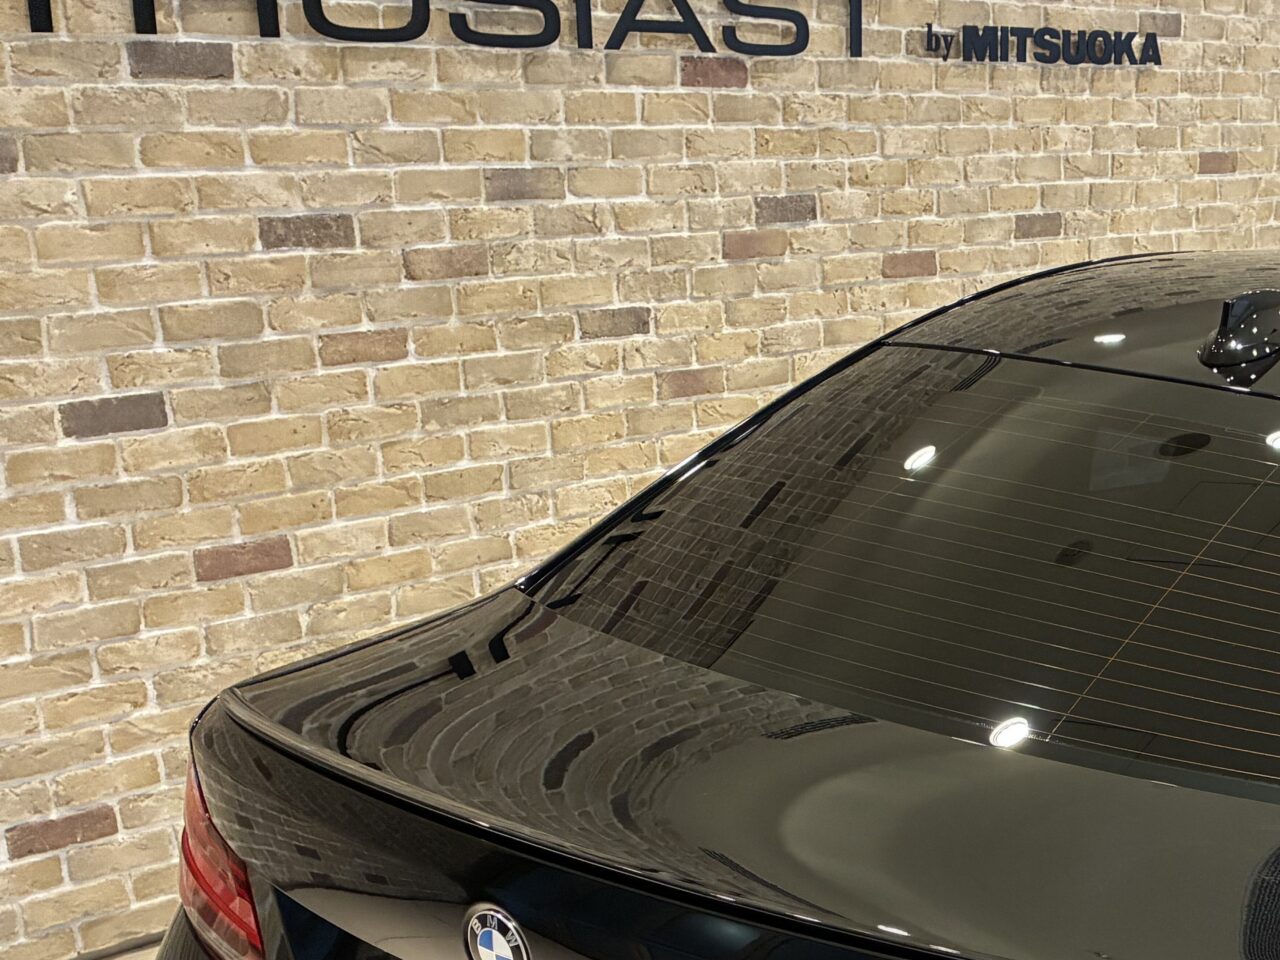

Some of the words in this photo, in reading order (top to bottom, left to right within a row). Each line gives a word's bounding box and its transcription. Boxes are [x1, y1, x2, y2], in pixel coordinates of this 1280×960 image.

[926, 23, 954, 61] by
[962, 25, 1161, 65] MITSUOKA
[472, 914, 520, 947] BMW
